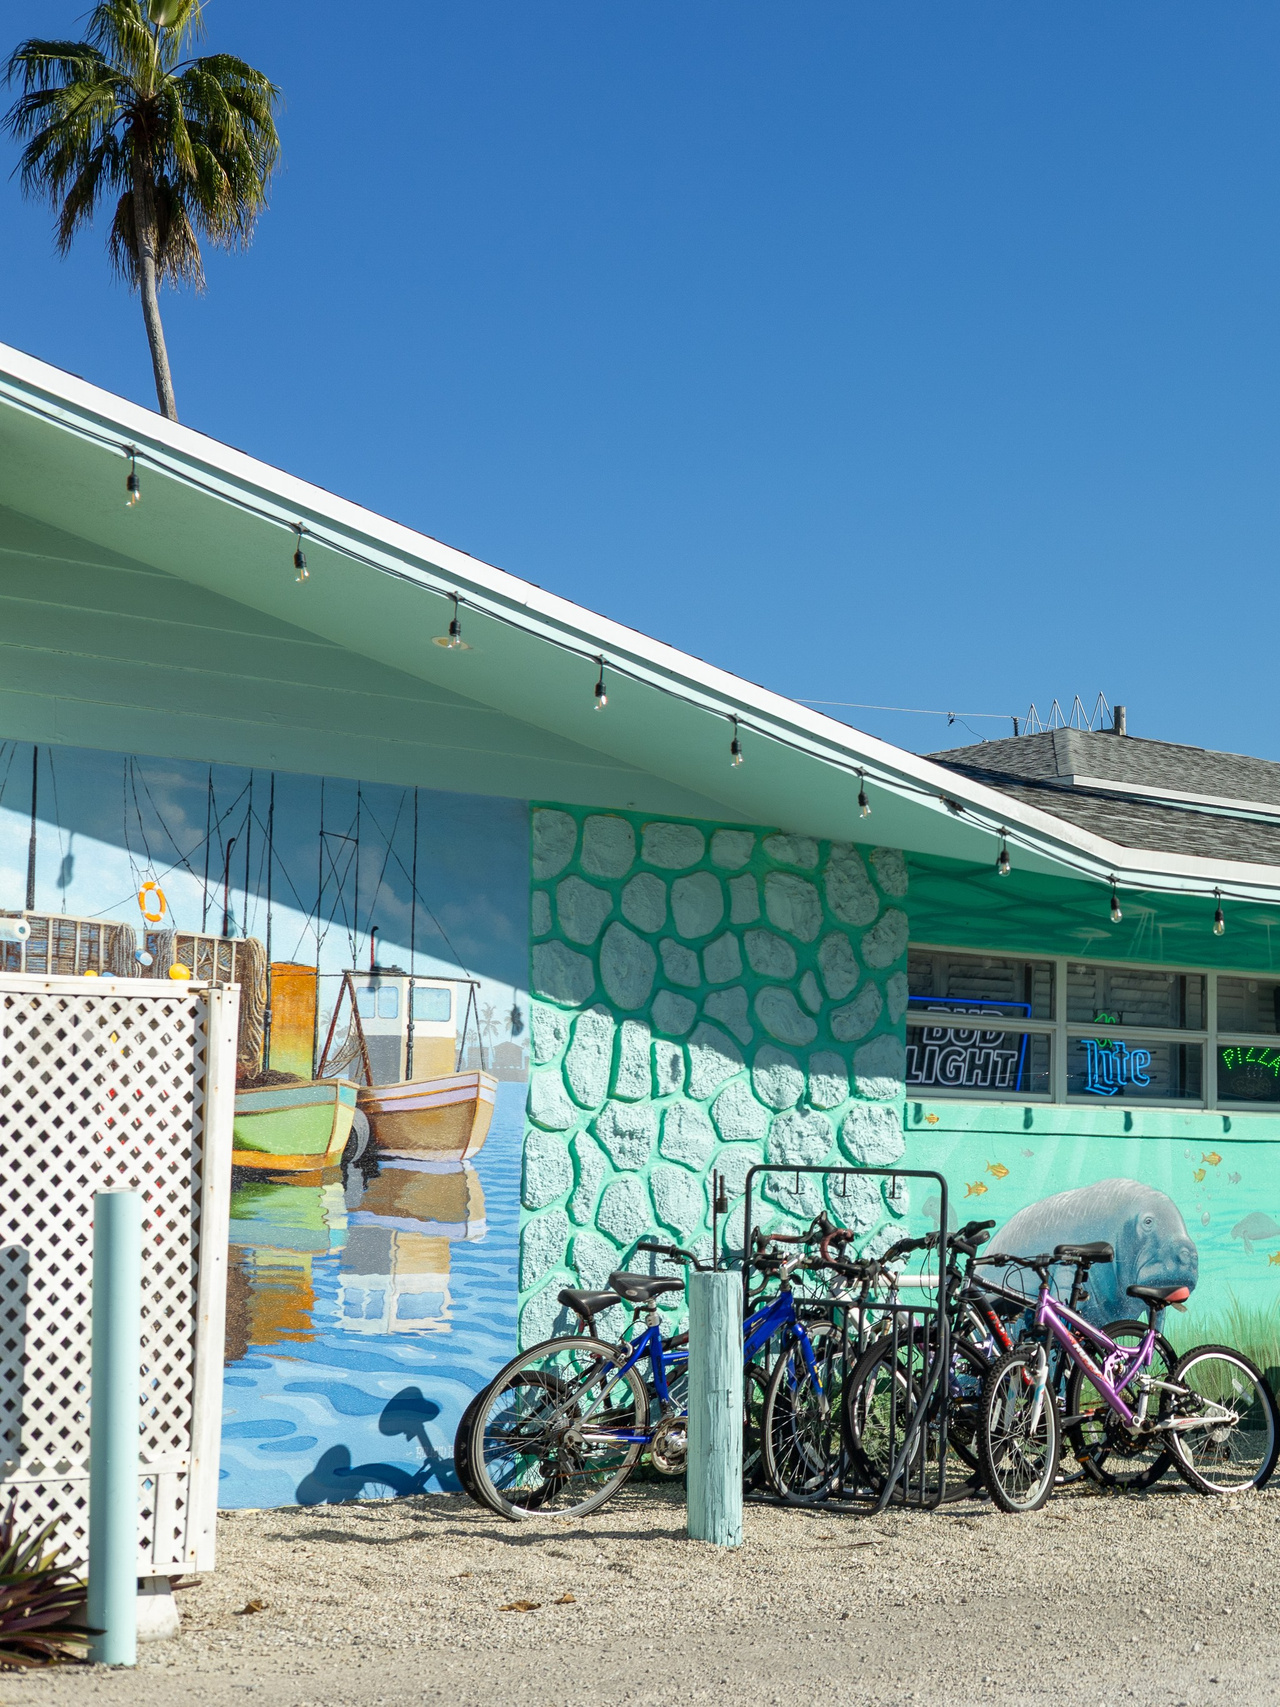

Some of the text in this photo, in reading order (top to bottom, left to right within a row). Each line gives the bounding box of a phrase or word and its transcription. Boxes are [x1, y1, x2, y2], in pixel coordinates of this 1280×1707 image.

[923, 1006, 1005, 1047] BUD
[905, 1046, 1018, 1087] LIGHT
[1081, 1040, 1151, 1096] Lite
